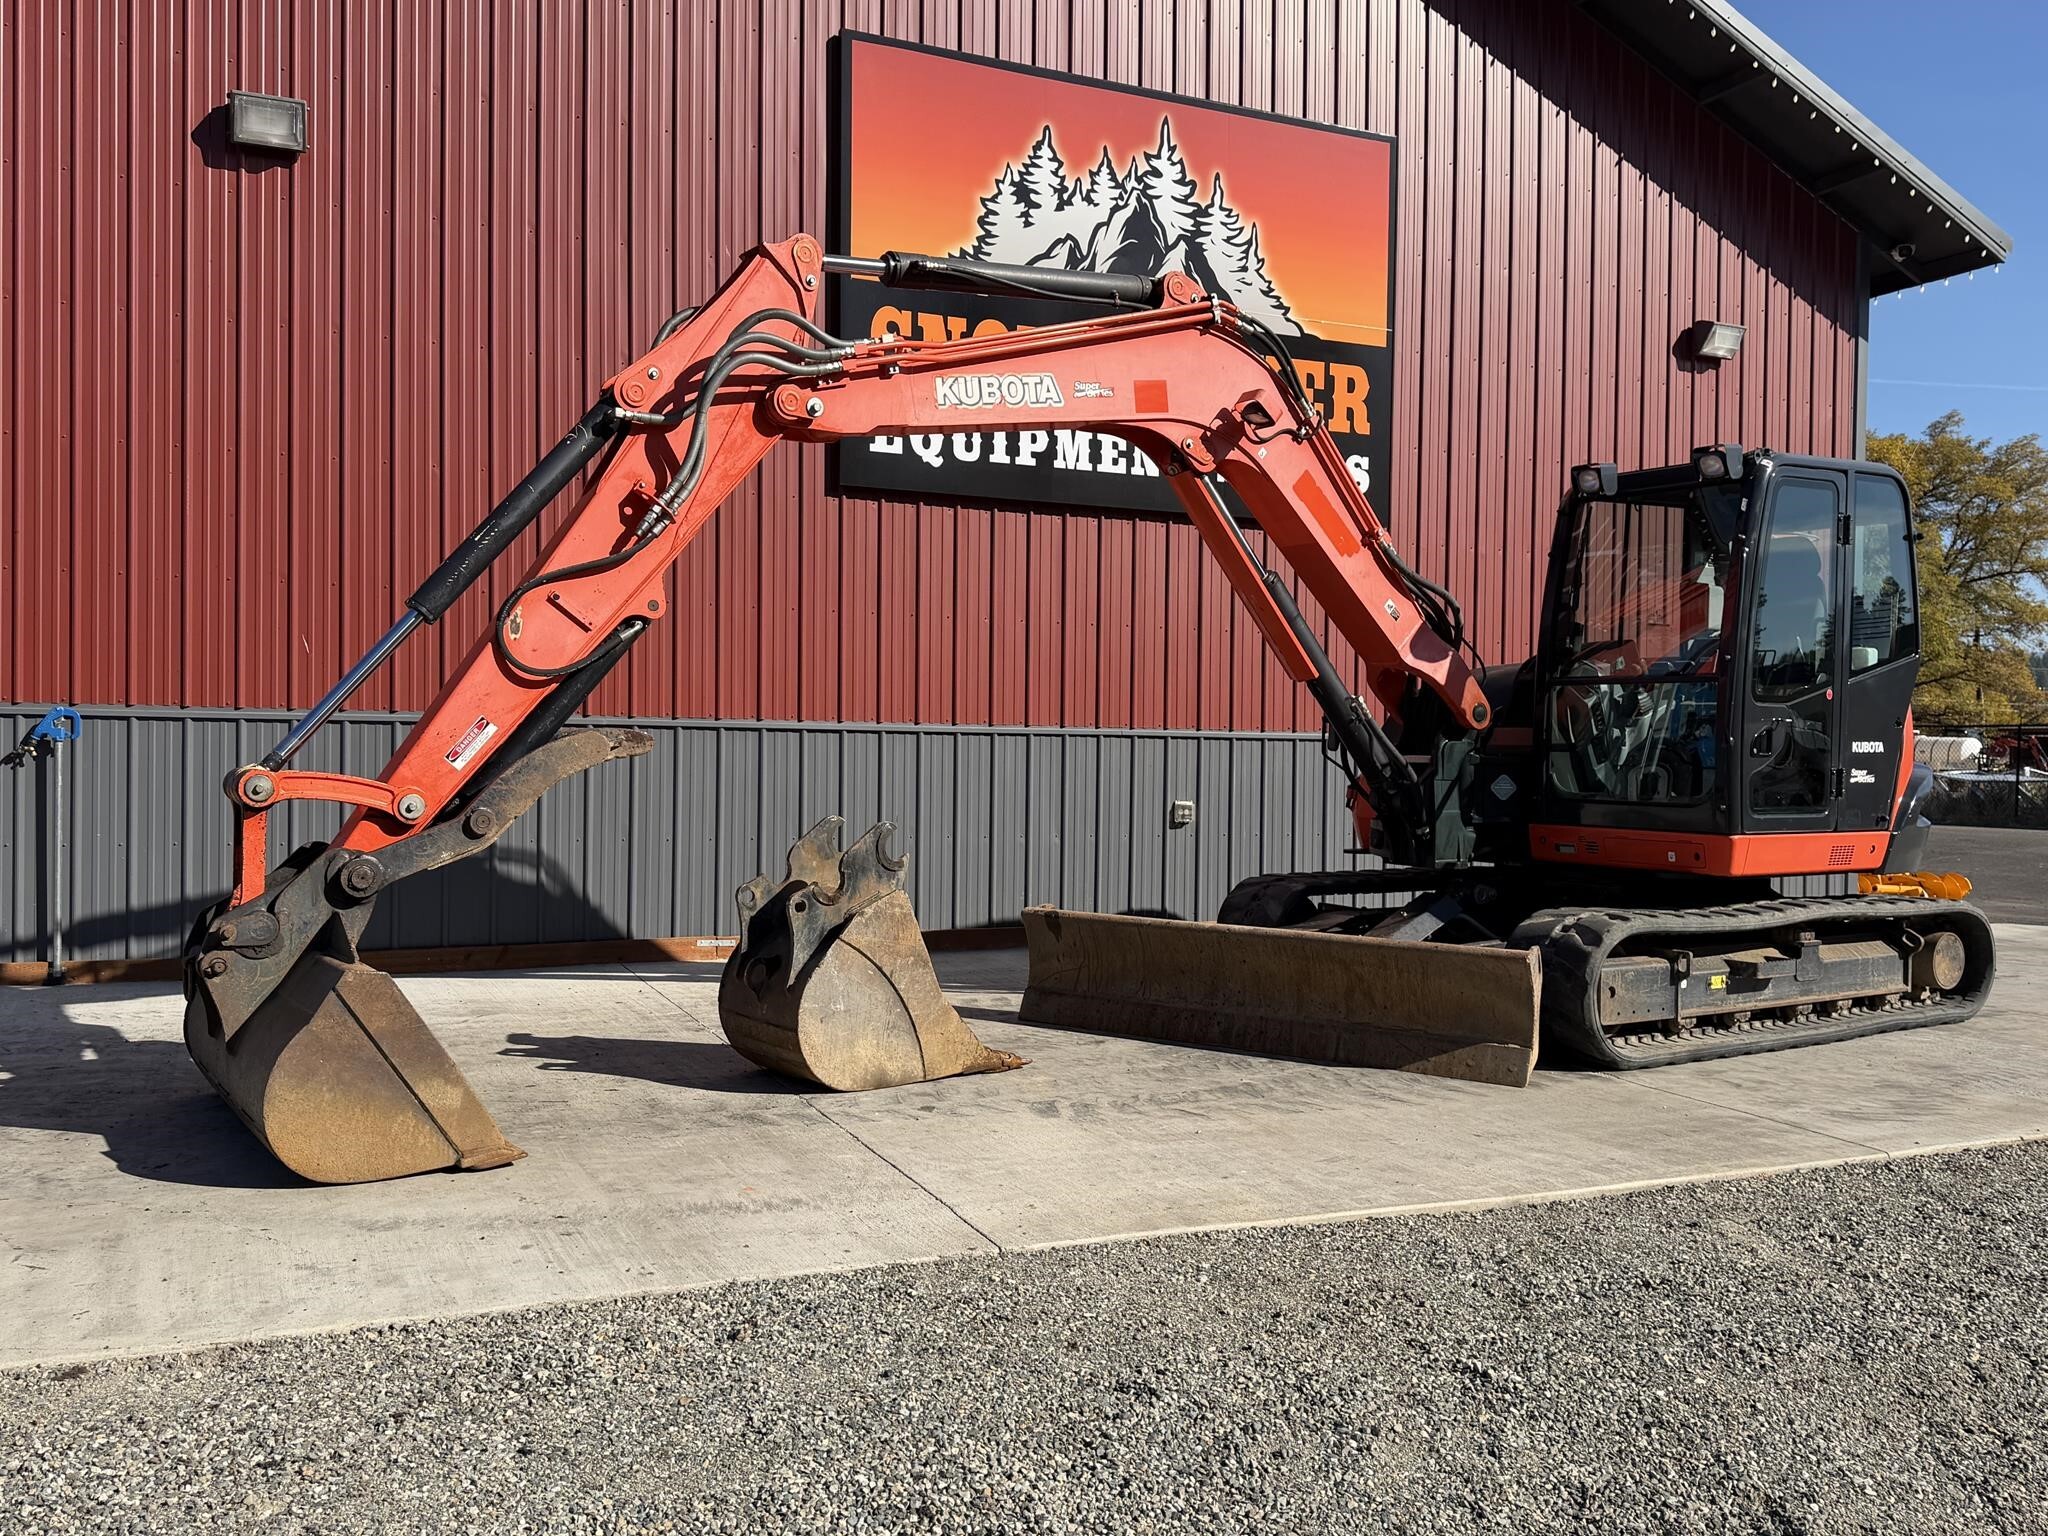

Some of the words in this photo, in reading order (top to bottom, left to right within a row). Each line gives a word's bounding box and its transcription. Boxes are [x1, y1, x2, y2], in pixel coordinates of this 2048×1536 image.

[934, 374, 1063, 407] KUBOTA
[1074, 381, 1101, 391] Super
[869, 430, 1160, 477] QUIPMEN
[456, 727, 480, 753] DANGER
[1852, 741, 1884, 753] KUBOTA
